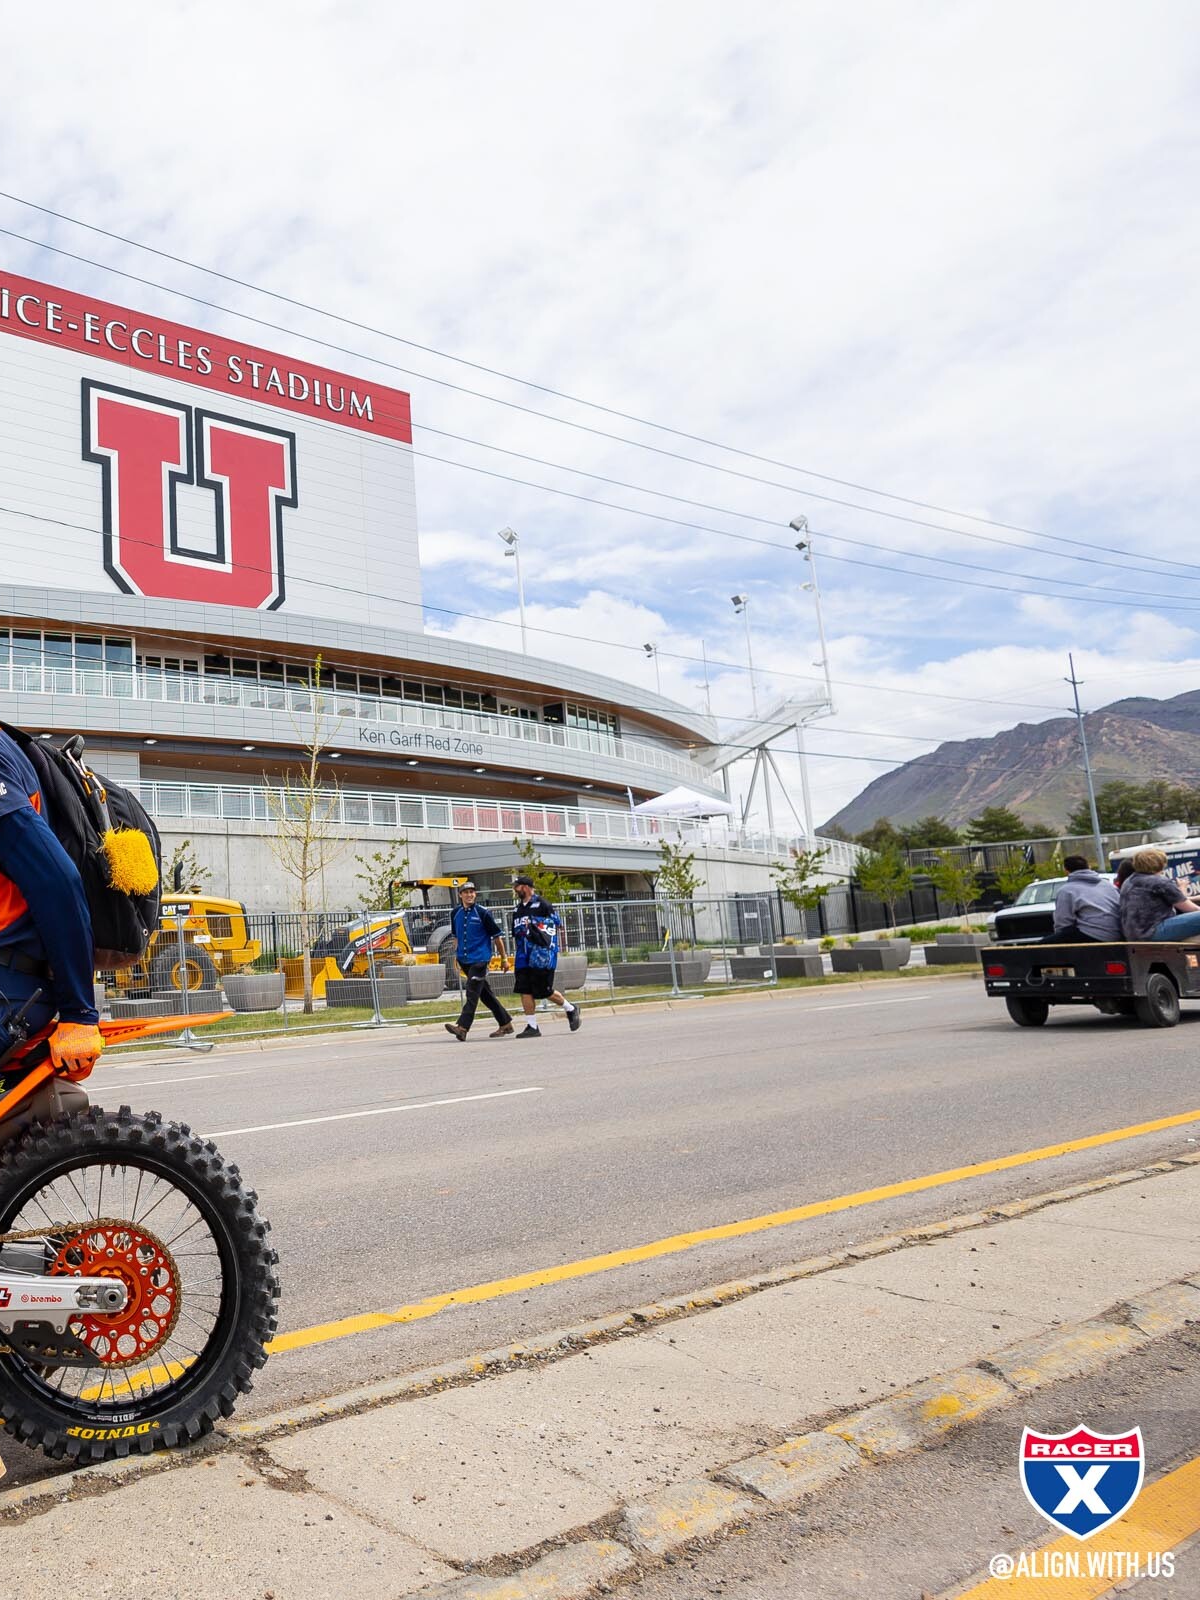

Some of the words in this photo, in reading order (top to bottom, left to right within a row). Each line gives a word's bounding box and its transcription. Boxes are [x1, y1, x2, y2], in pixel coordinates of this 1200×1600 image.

[226, 354, 375, 422] STADIUM
[81, 377, 298, 611] U
[359, 727, 386, 745] Ken
[389, 730, 422, 749] Garff
[425, 734, 451, 752] Red
[454, 738, 484, 756] Zone
[162, 904, 177, 916] CAT
[30, 1294, 62, 1303] brembo
[66, 1421, 151, 1440] DUNLOP
